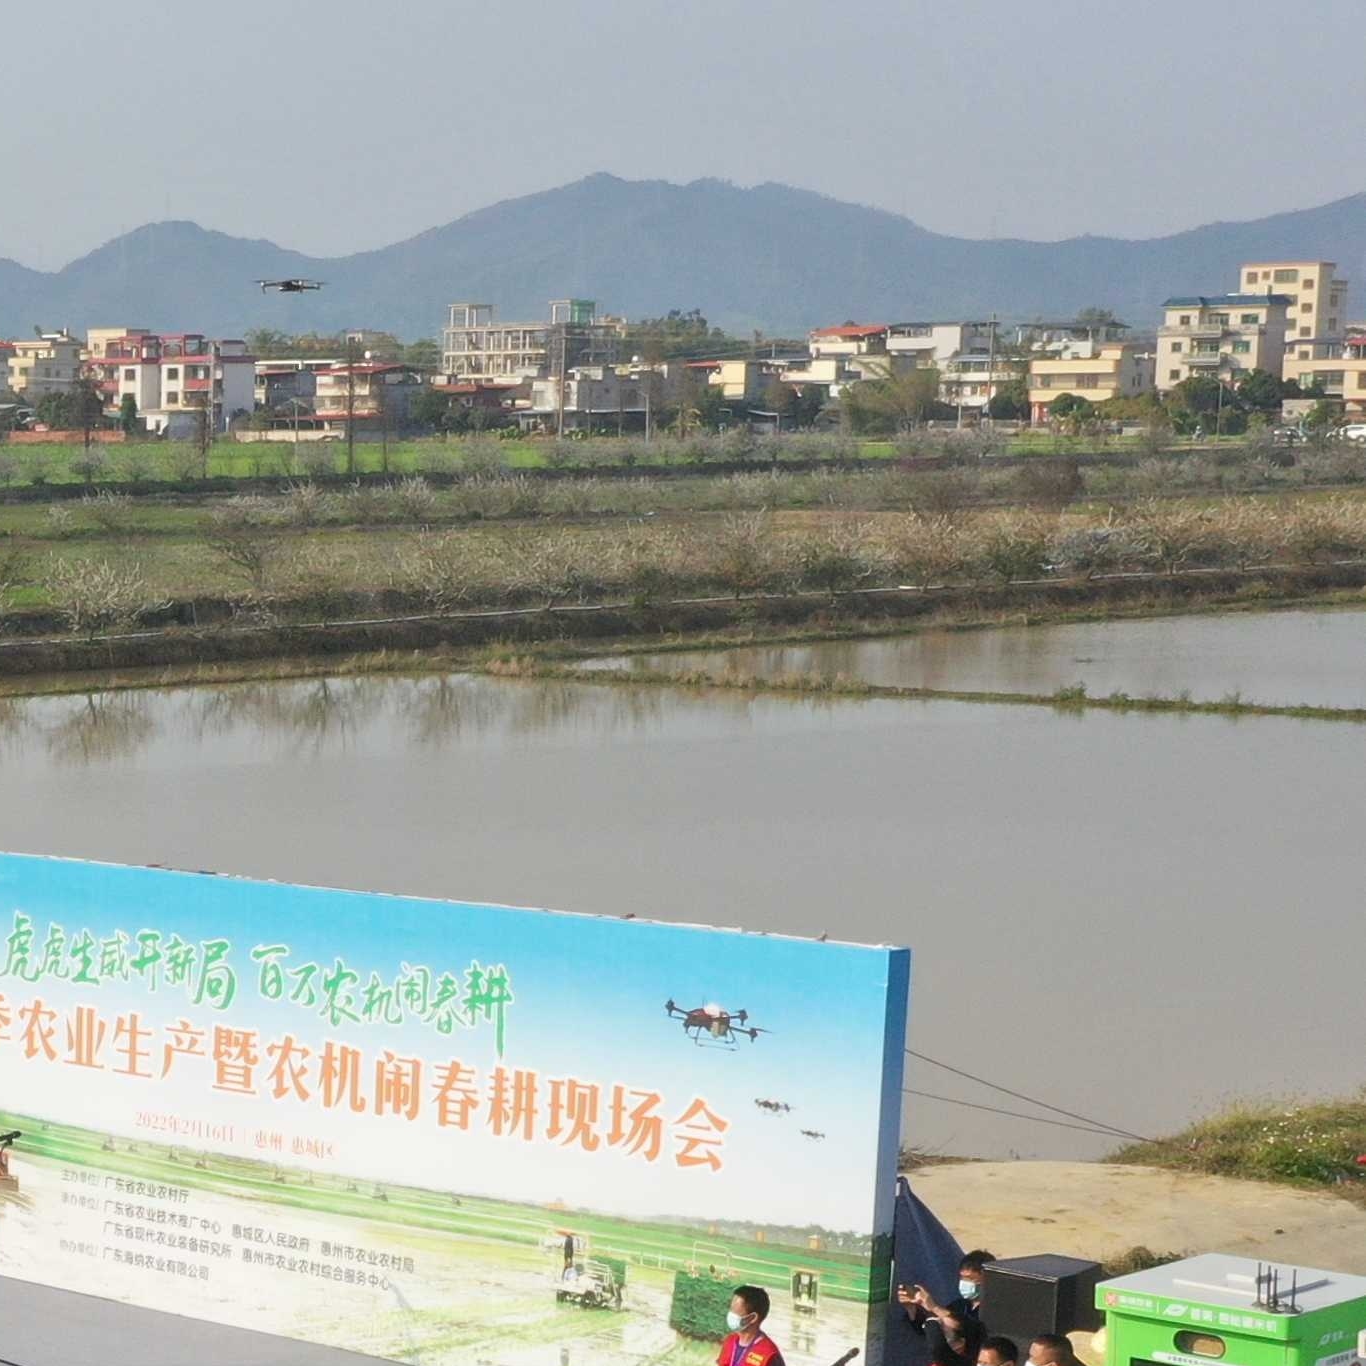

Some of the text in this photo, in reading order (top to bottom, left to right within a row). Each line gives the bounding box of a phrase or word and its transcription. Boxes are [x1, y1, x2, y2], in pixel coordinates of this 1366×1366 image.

[251, 944, 514, 1058] 百万农机闹春耕
[104, 1176, 189, 1204] 广东省农业农村厅
[101, 1246, 210, 1281] 广东海纳农业有限公司
[102, 1221, 391, 1292] 广东省现代农业装备研究所 惠州市农业农村综合服务中心
[103, 1200, 221, 1235] 广东省农业技术推广中心
[231, 1223, 310, 1252] 惠城区人民政府
[320, 1241, 415, 1275] 惠州市农业农村局
